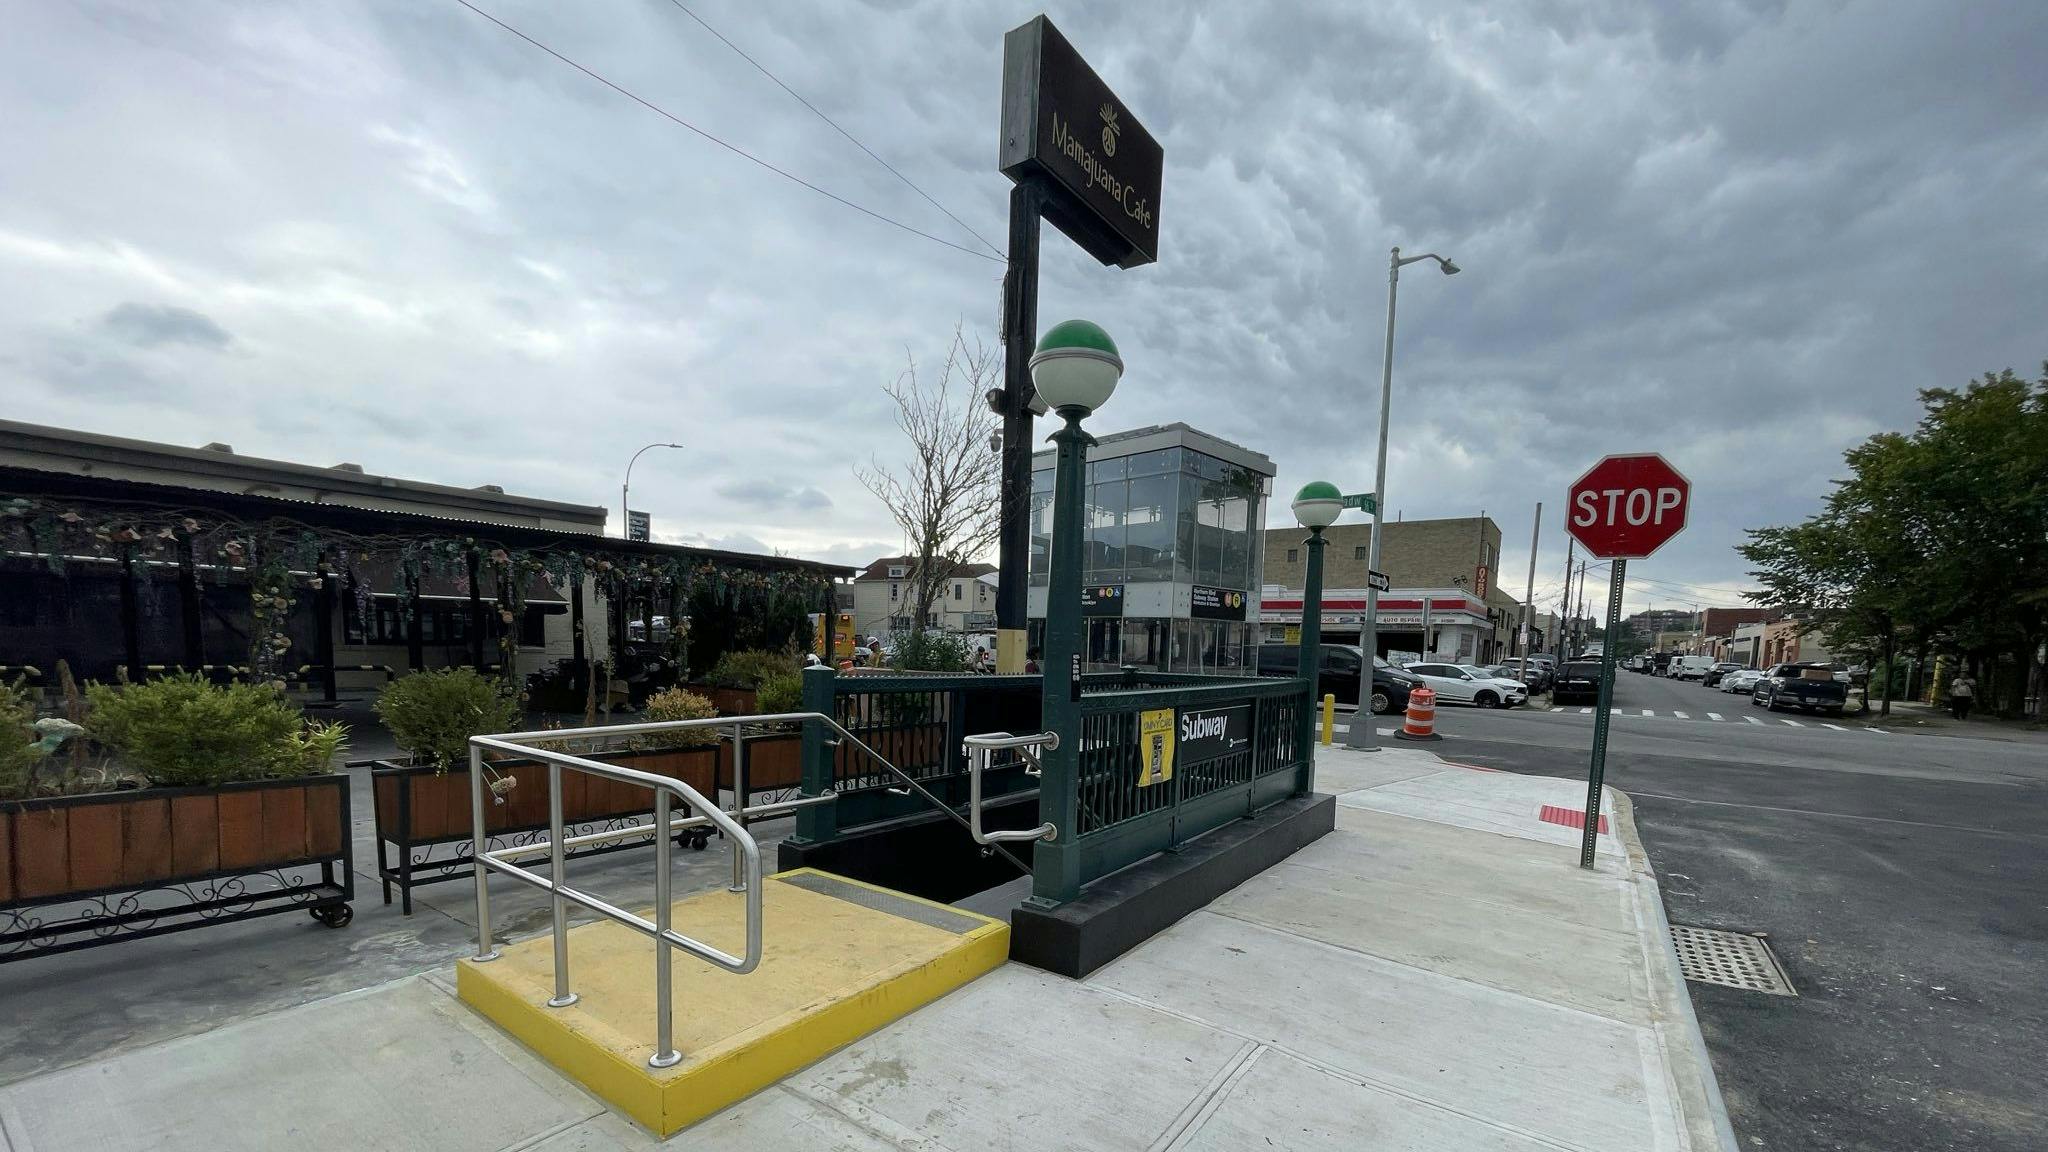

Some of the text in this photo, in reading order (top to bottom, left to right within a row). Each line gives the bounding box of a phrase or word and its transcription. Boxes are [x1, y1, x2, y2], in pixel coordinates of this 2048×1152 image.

[1051, 111, 1151, 229] Mamajuana Cafe
[1573, 487, 1682, 527] STOP
[1181, 713, 1228, 742] Subway
